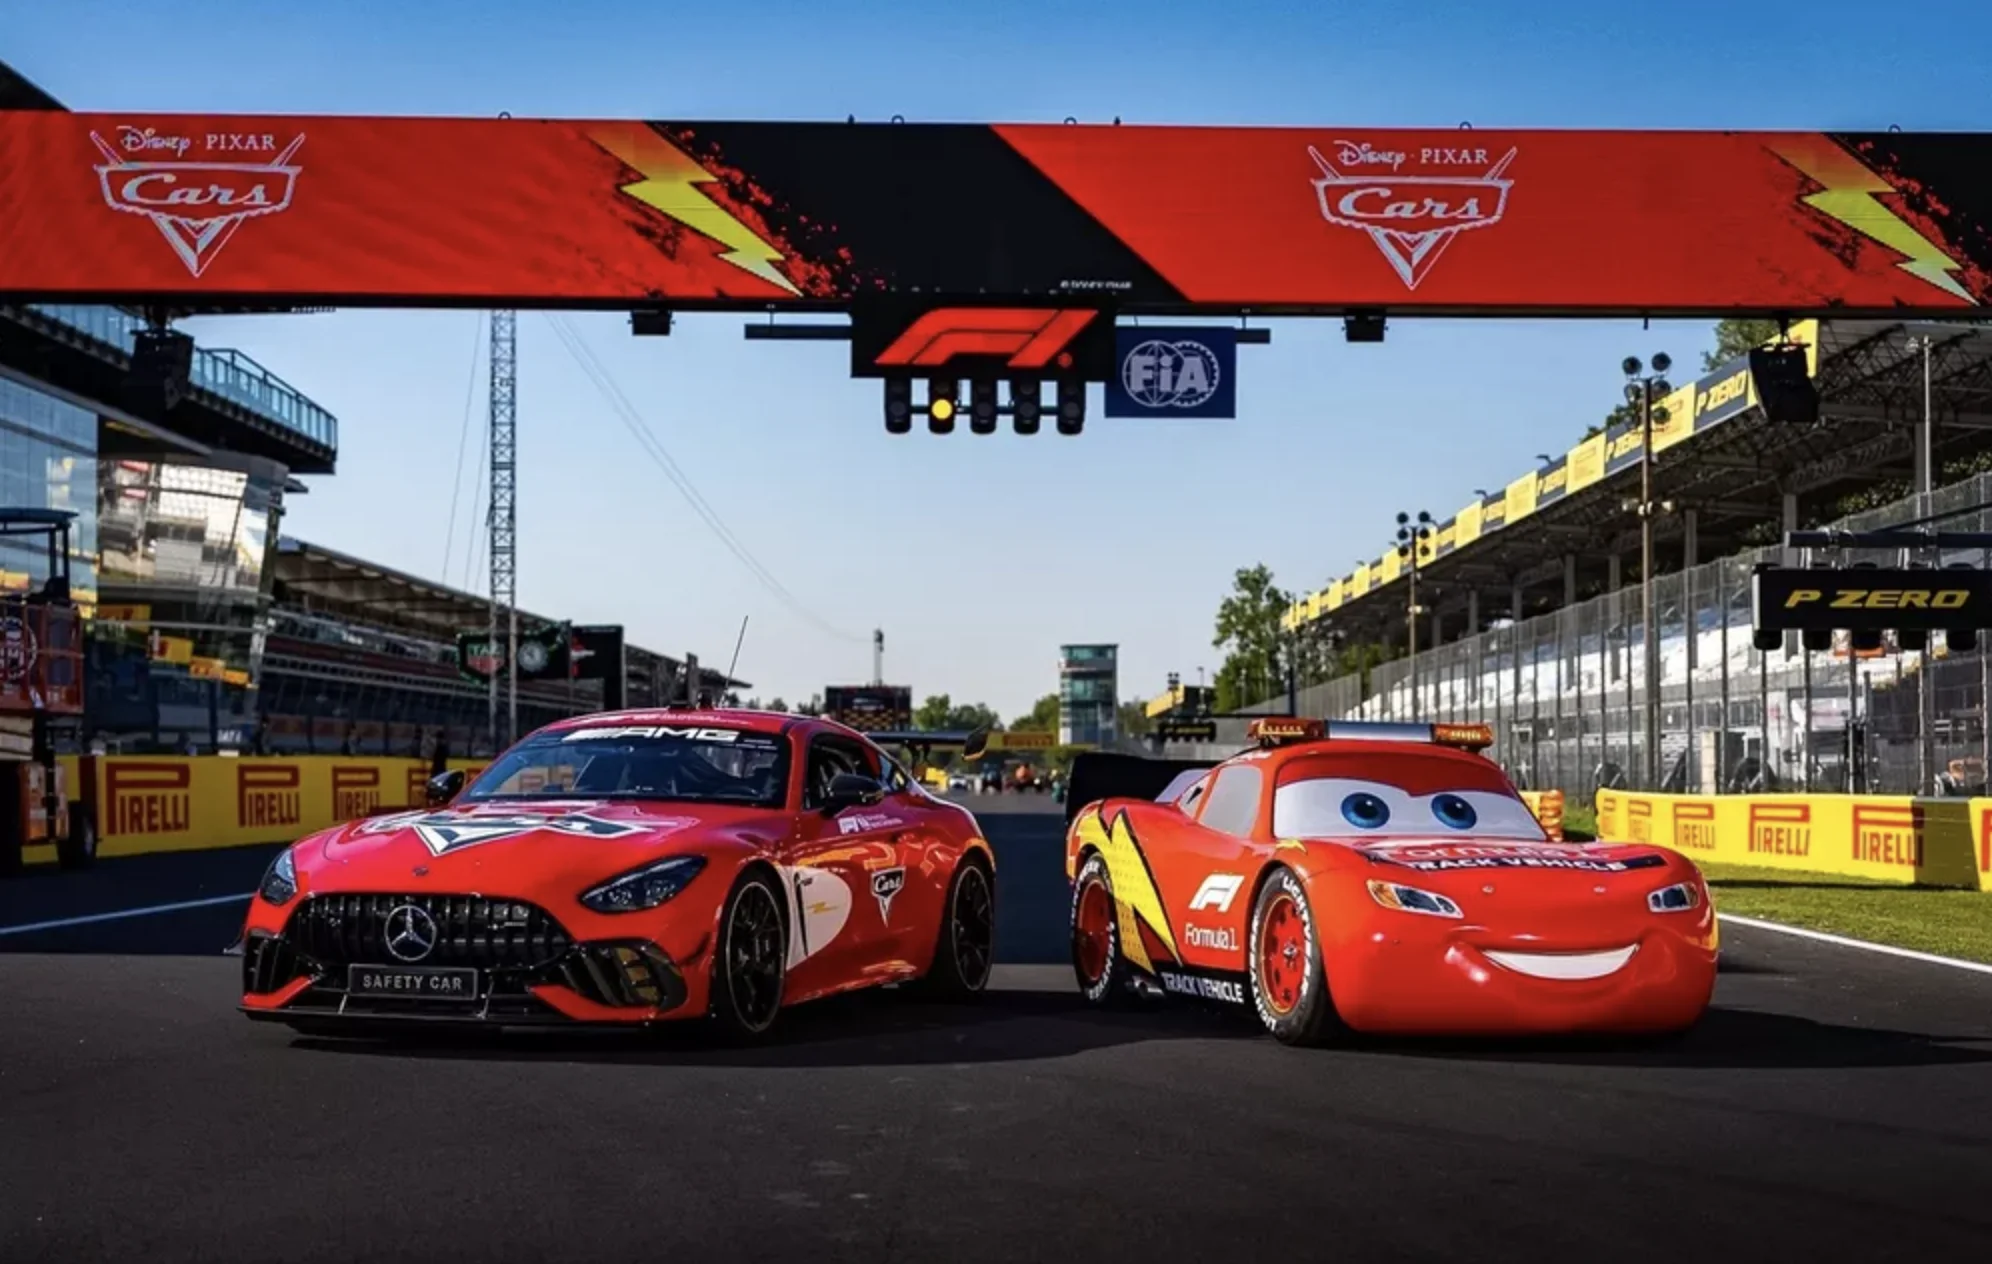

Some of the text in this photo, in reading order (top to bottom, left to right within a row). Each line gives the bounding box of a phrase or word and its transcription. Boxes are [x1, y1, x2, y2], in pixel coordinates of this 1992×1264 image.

[116, 125, 275, 158] Disney PIXAR
[1334, 140, 1489, 171] Disney PIXAR
[121, 173, 272, 205] Cars
[1338, 187, 1484, 219] Cars
[1695, 368, 1748, 417] P ZERO
[1784, 589, 1971, 609] P ZERO
[618, 726, 740, 743] AMG
[106, 762, 190, 835] PIRELLI
[237, 764, 300, 829] PIRELLI
[1673, 802, 1716, 850] PIRELLI
[1749, 803, 1811, 857] PIRELLI
[1852, 804, 1925, 869] PIRELLI
[1501, 857, 1628, 872] VEHICLE
[363, 974, 463, 991] SAFETY CAR
[1161, 972, 1245, 1004] TRACK VEHICLE
